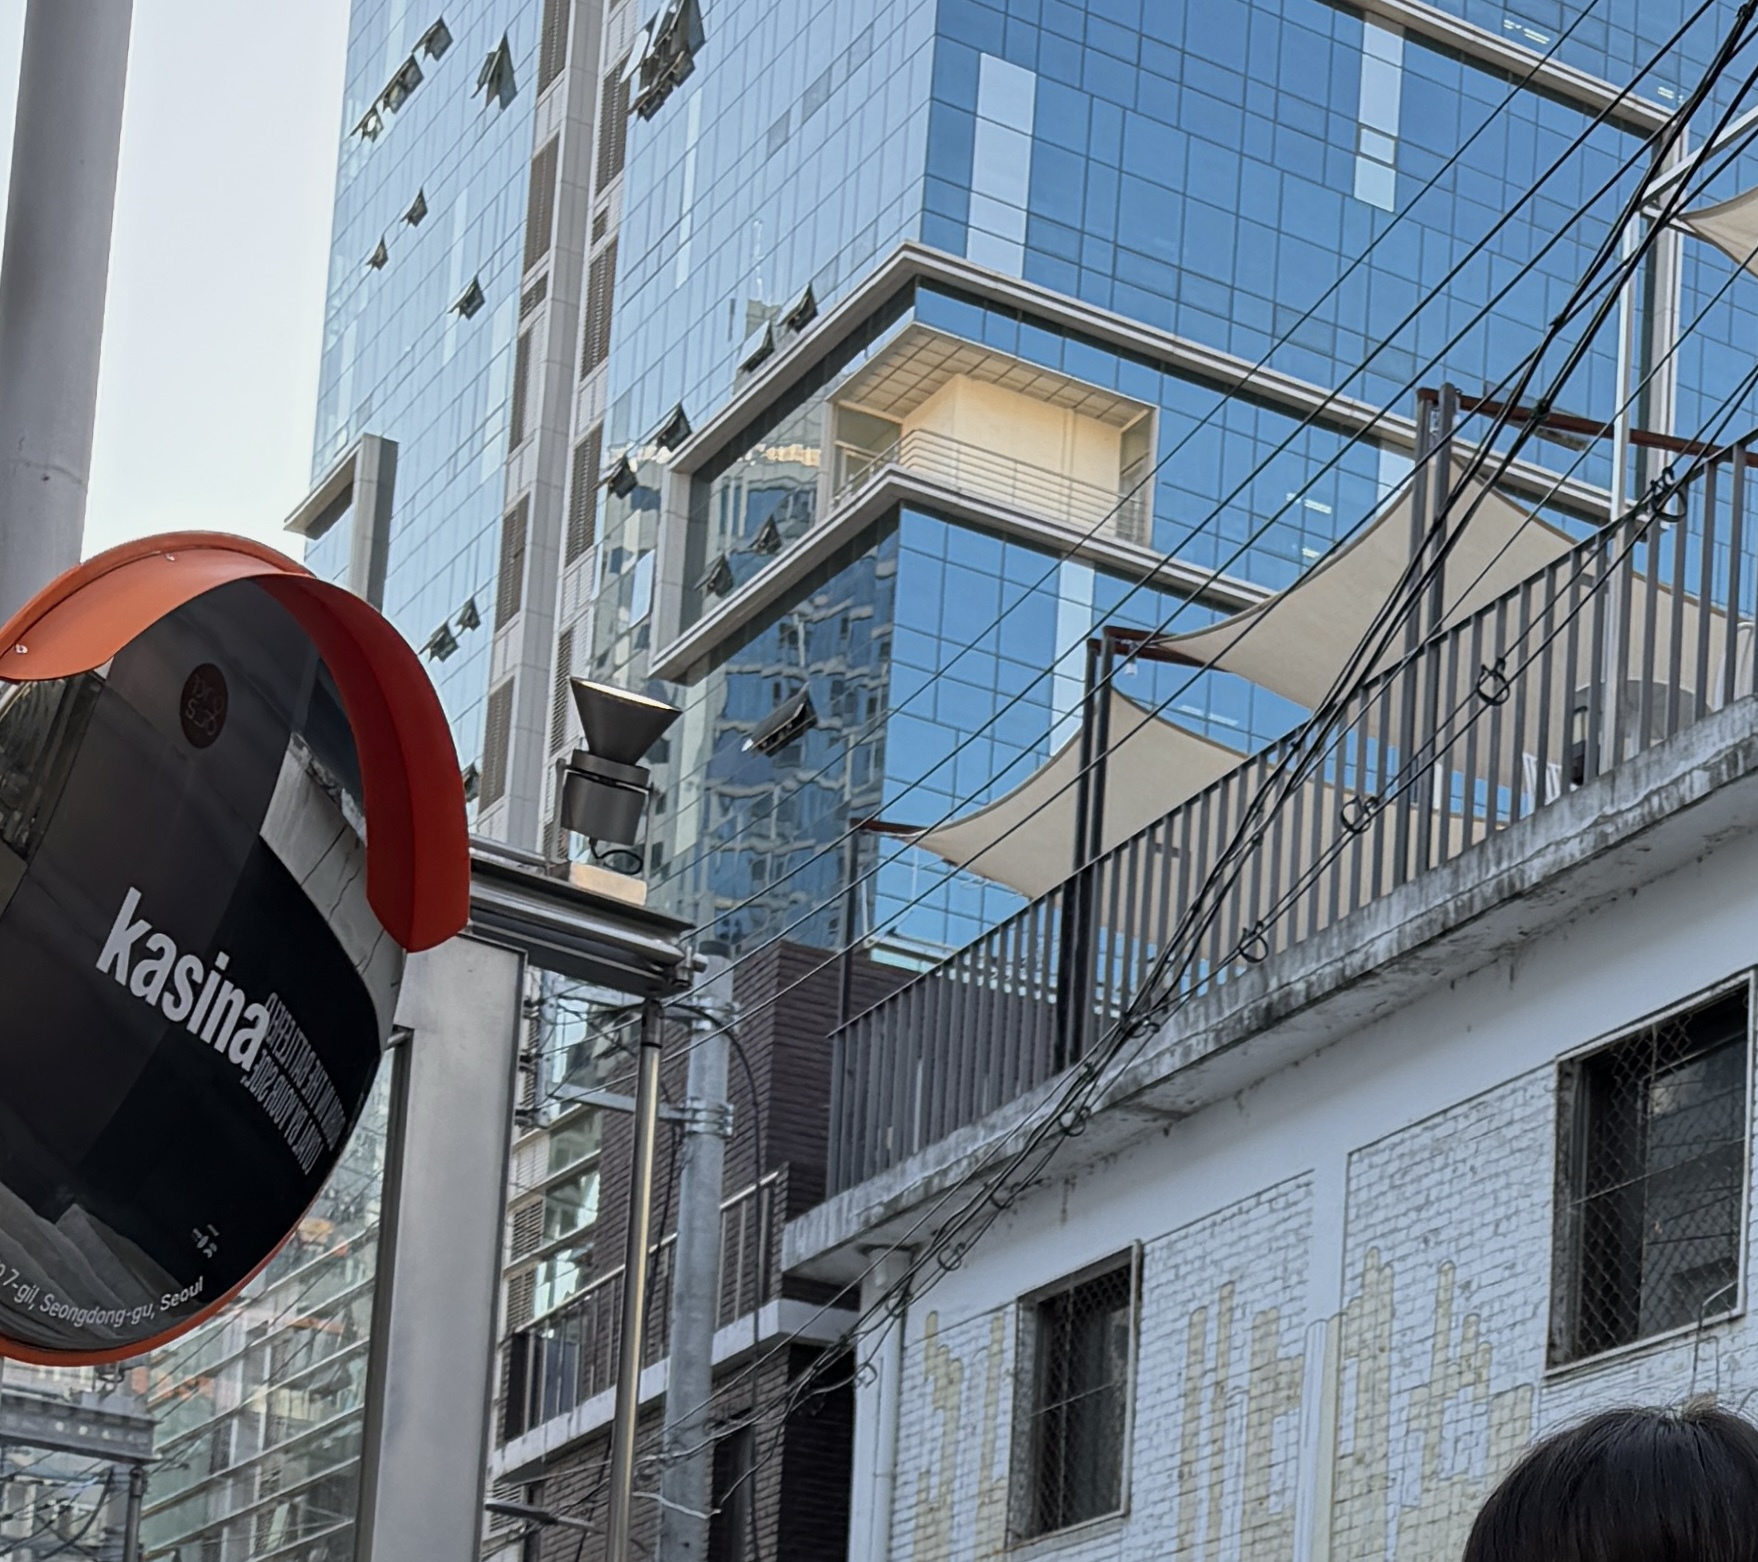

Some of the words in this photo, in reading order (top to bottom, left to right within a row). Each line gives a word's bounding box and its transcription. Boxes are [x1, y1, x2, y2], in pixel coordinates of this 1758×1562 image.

[95, 886, 270, 1071] kasina
[2, 1268, 39, 1311] 7-gil,
[39, 1293, 155, 1328] Seongdong-gu,
[159, 1275, 204, 1312] Seoul
